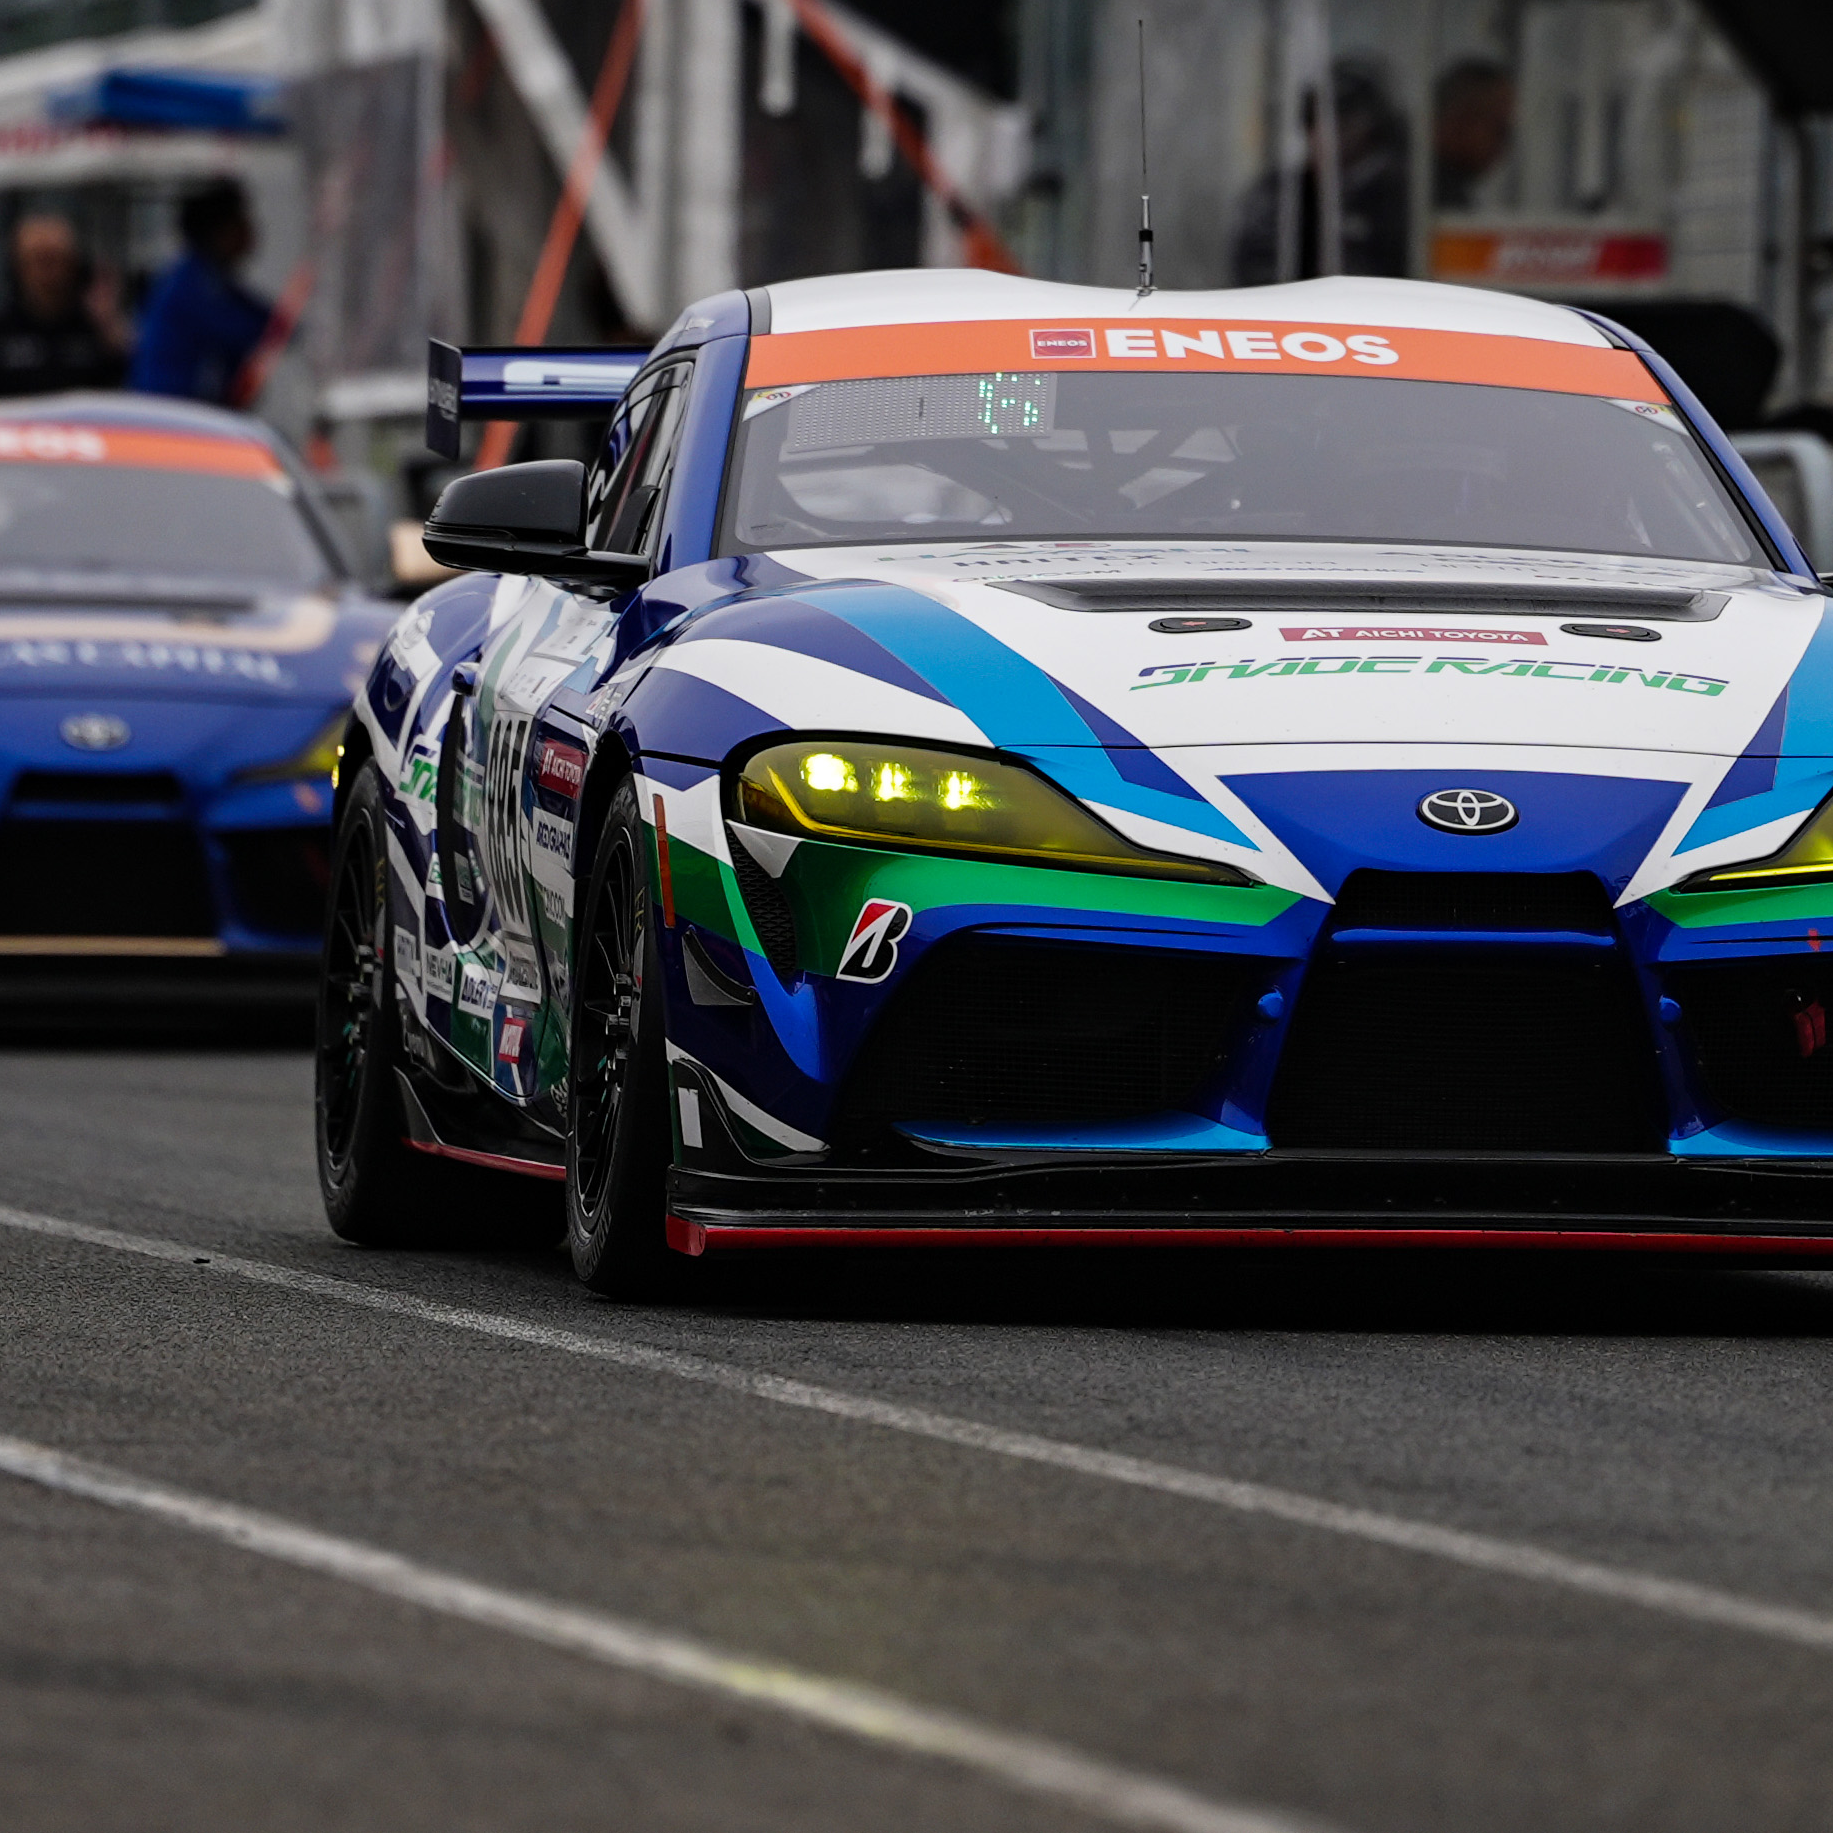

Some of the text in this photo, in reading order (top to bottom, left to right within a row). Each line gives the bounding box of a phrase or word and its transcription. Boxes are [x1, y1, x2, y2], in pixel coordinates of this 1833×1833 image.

[1104, 329, 1399, 365] ENEOS
[1301, 627, 1528, 643] AT AICHI TOYOTA
[1129, 655, 1730, 697] SHADE RACING
